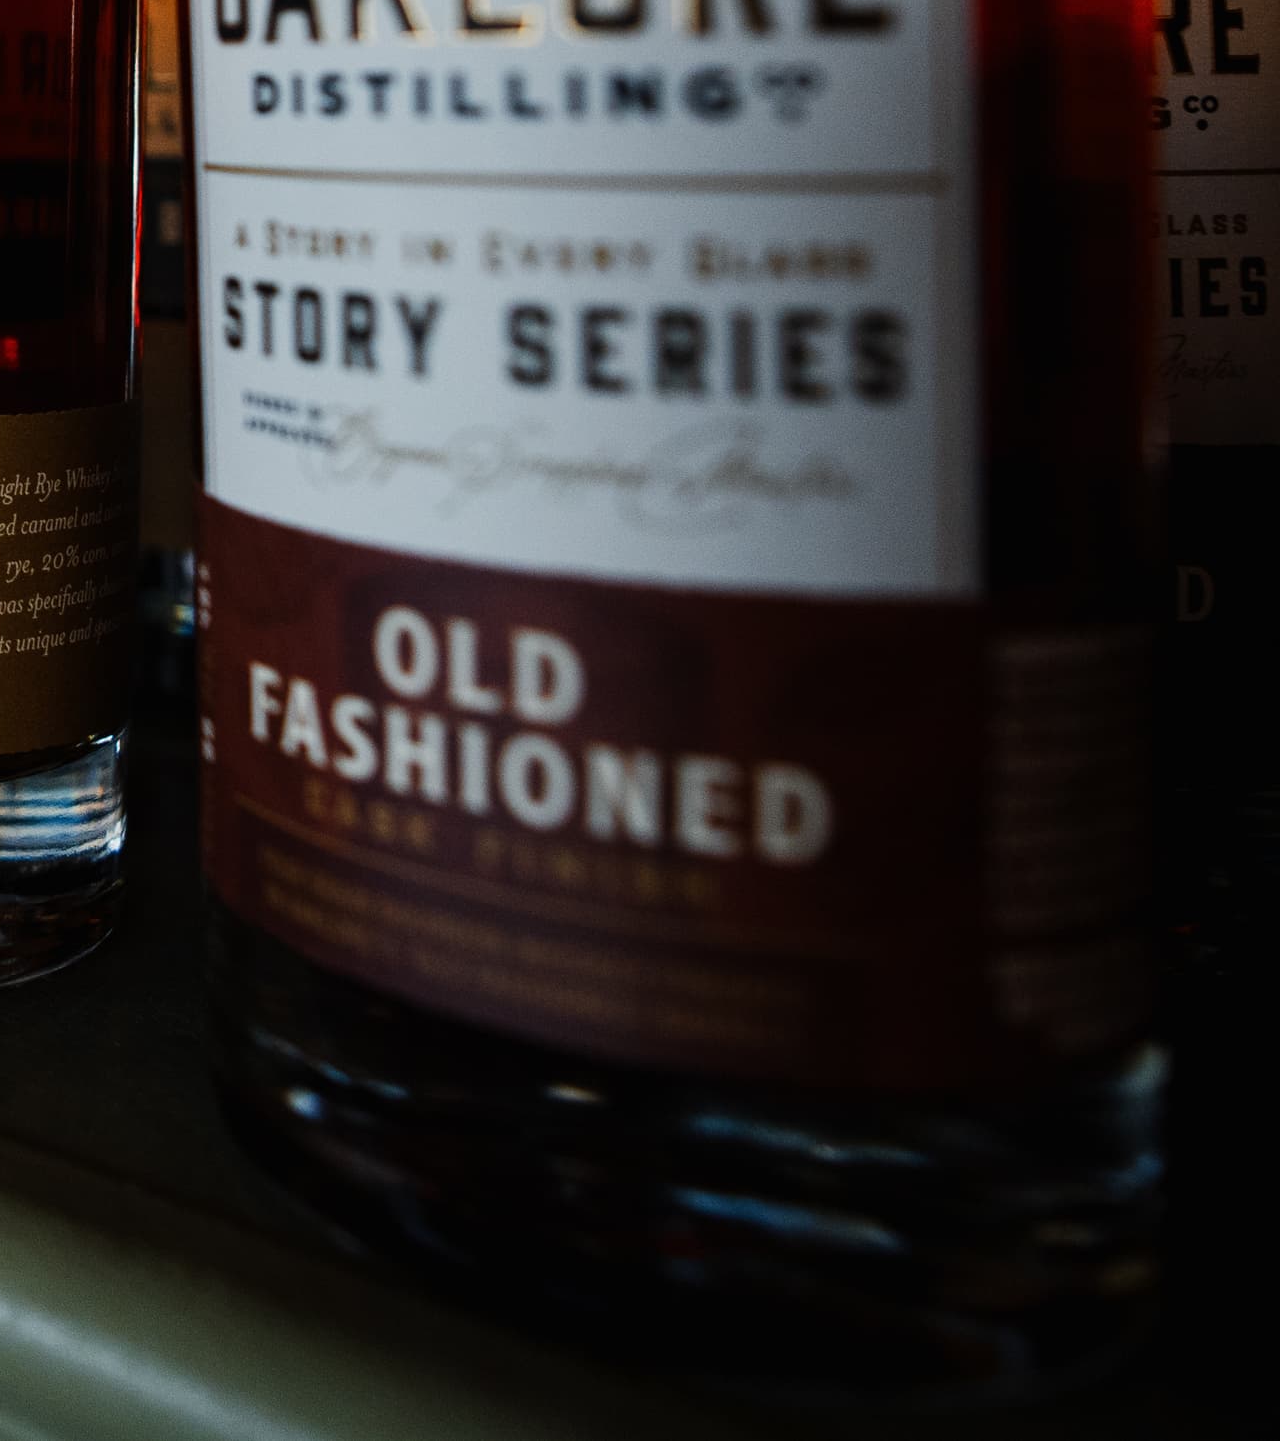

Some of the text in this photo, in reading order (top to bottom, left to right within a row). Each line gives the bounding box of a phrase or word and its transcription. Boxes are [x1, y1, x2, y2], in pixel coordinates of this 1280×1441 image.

[252, 62, 743, 124] DISTILLING
[223, 275, 912, 405] STORY SERIES
[34, 471, 61, 503] Rye
[20, 505, 79, 536] caramel
[5, 558, 35, 584] rye,
[41, 544, 79, 572] 20%
[26, 578, 97, 620] specifically
[15, 630, 67, 656] unique
[68, 616, 93, 643] and
[372, 603, 588, 727] OLD
[247, 659, 837, 867] FASHIONED
